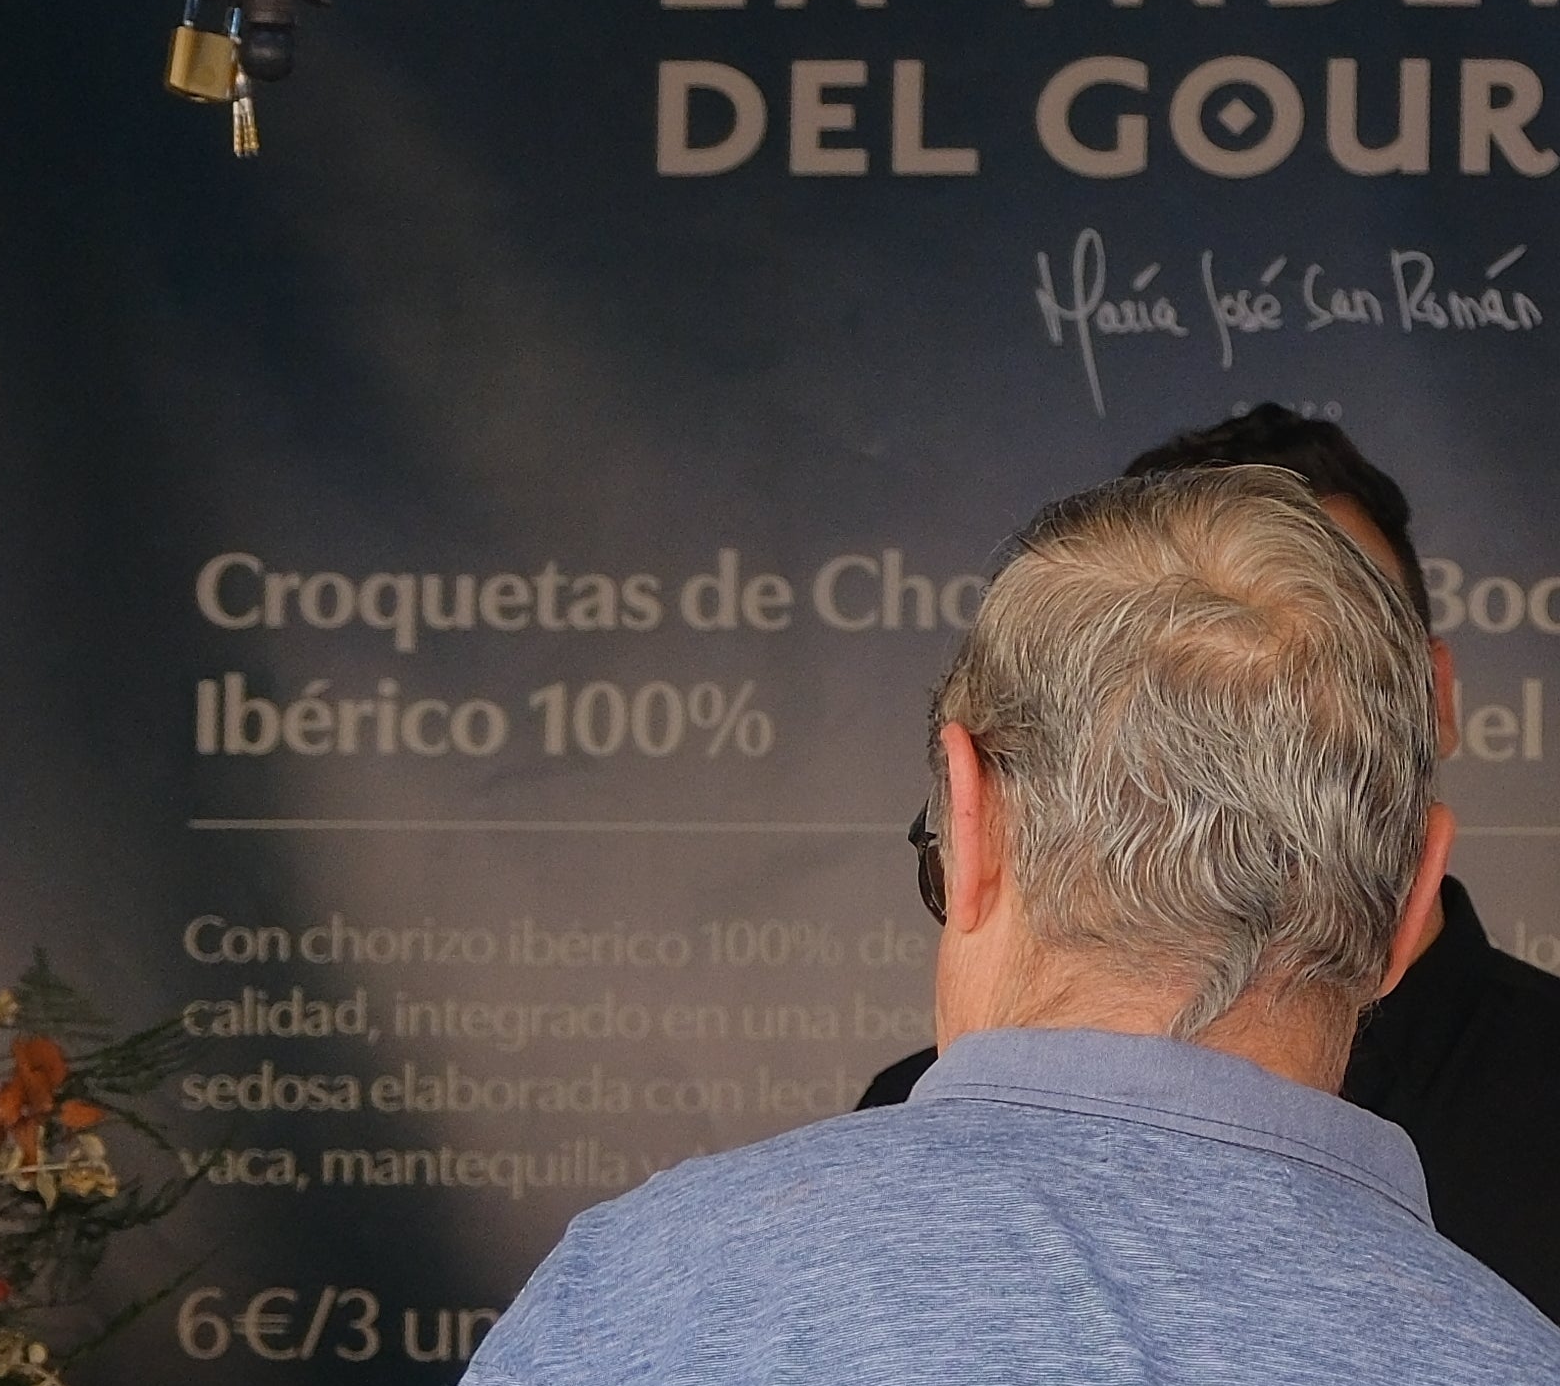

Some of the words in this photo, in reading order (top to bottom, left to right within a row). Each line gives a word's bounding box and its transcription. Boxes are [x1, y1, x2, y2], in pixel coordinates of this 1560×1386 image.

[655, 58, 980, 177] DEL
[1035, 227, 1190, 417] María
[1201, 247, 1287, 370] José
[195, 551, 661, 654] Croquetas
[679, 547, 795, 633] de
[811, 547, 988, 634] Cho
[195, 671, 509, 759] Ibérico
[527, 679, 776, 761] 100%
[182, 913, 292, 966] Con
[299, 913, 495, 968] chorizo
[508, 916, 691, 969] ibérico
[708, 919, 839, 969] 100%
[858, 918, 927, 969] de
[182, 986, 381, 1044] calidad,
[394, 989, 654, 1050] integrado
[661, 1004, 730, 1041] en
[743, 1004, 839, 1042] una
[180, 1063, 361, 1116] sedosa
[370, 1064, 632, 1117] elaborada
[643, 1076, 745, 1117] con
[756, 1065, 868, 1117] lech
[177, 1143, 311, 1193] vaca,
[320, 1135, 628, 1200] mantequilla
[176, 1285, 381, 1362] 6€/3
[403, 1305, 504, 1362] un
